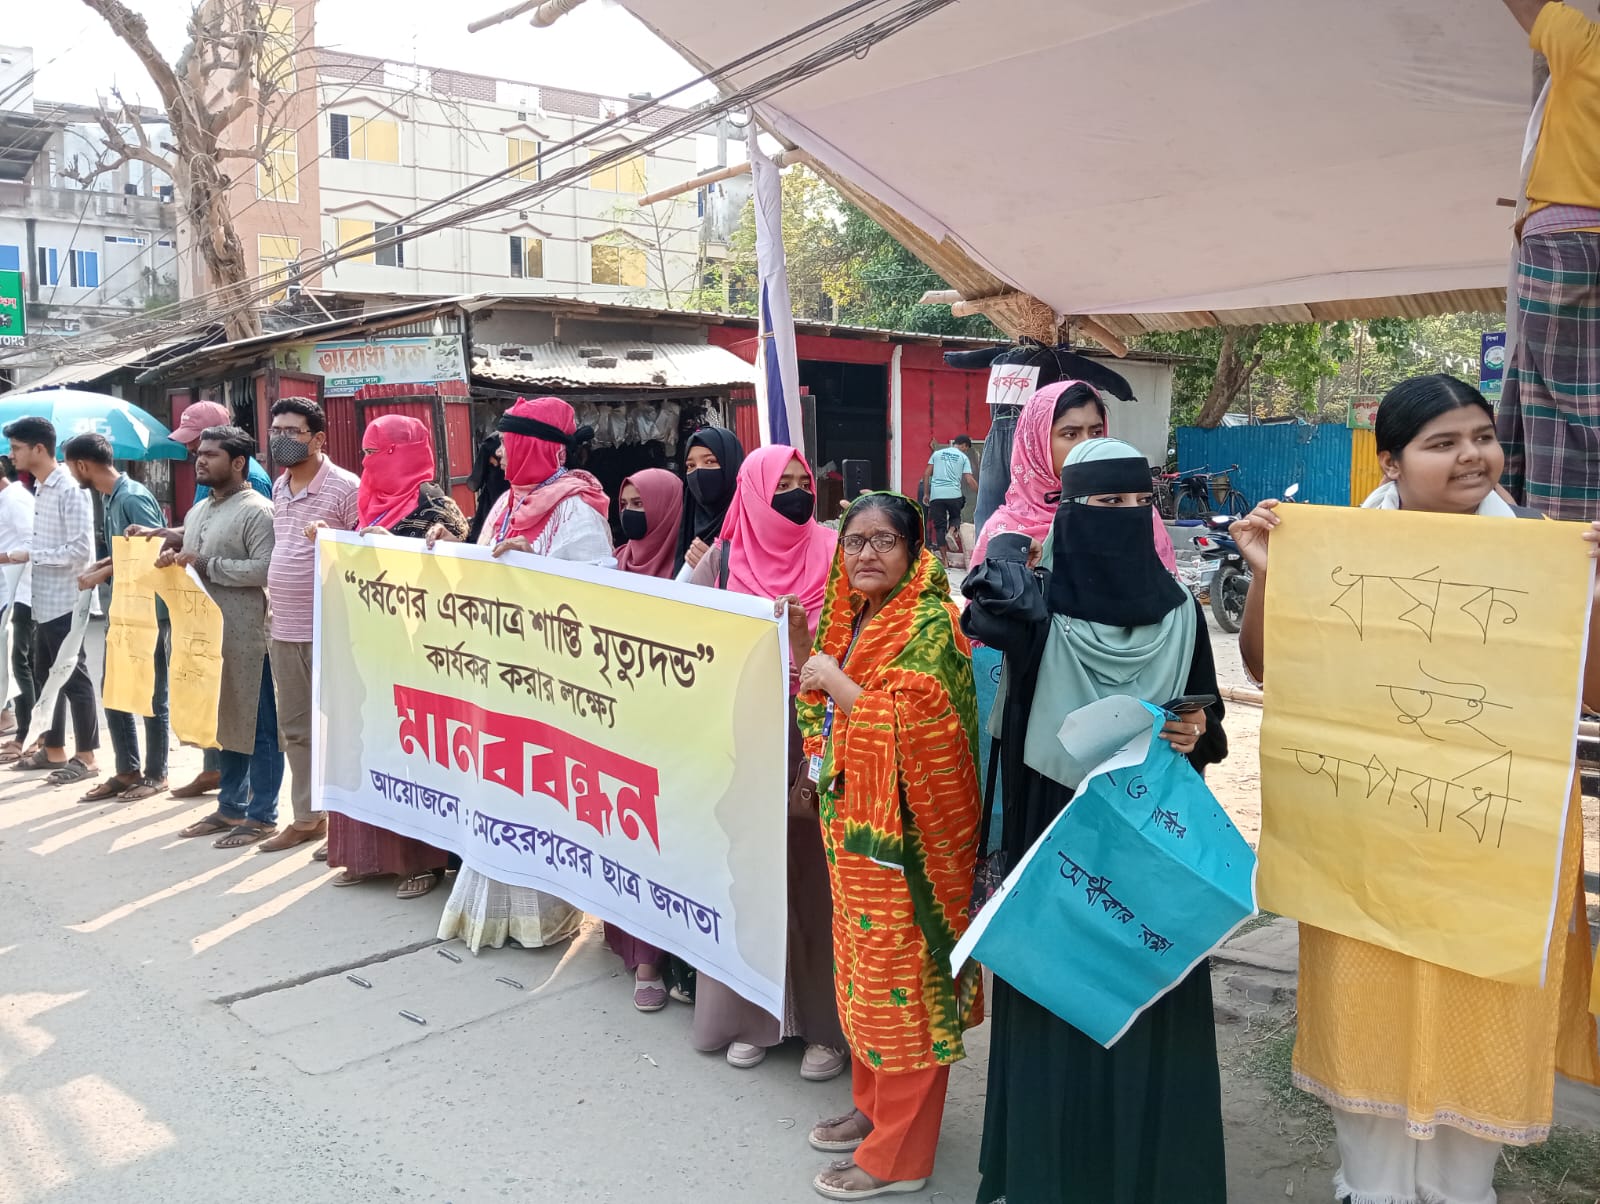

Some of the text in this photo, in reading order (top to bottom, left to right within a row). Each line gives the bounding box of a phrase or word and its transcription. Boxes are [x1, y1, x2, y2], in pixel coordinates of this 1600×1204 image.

[437, 592, 525, 642] একমাত্র
[528, 603, 584, 658] শাস্তি
[1331, 566, 1529, 645] ধর্ষক
[423, 641, 618, 729] কার্যকর করার লক্ষ্যে
[393, 684, 661, 857] মানববন্ধন
[1281, 749, 1523, 849] অপরাধী
[369, 769, 461, 825] আয়োজনে
[472, 810, 595, 879] মেহেরপুরের
[599, 854, 641, 904] ছাত্র
[647, 878, 722, 944] জনতা
[1151, 805, 1187, 840] নারীর
